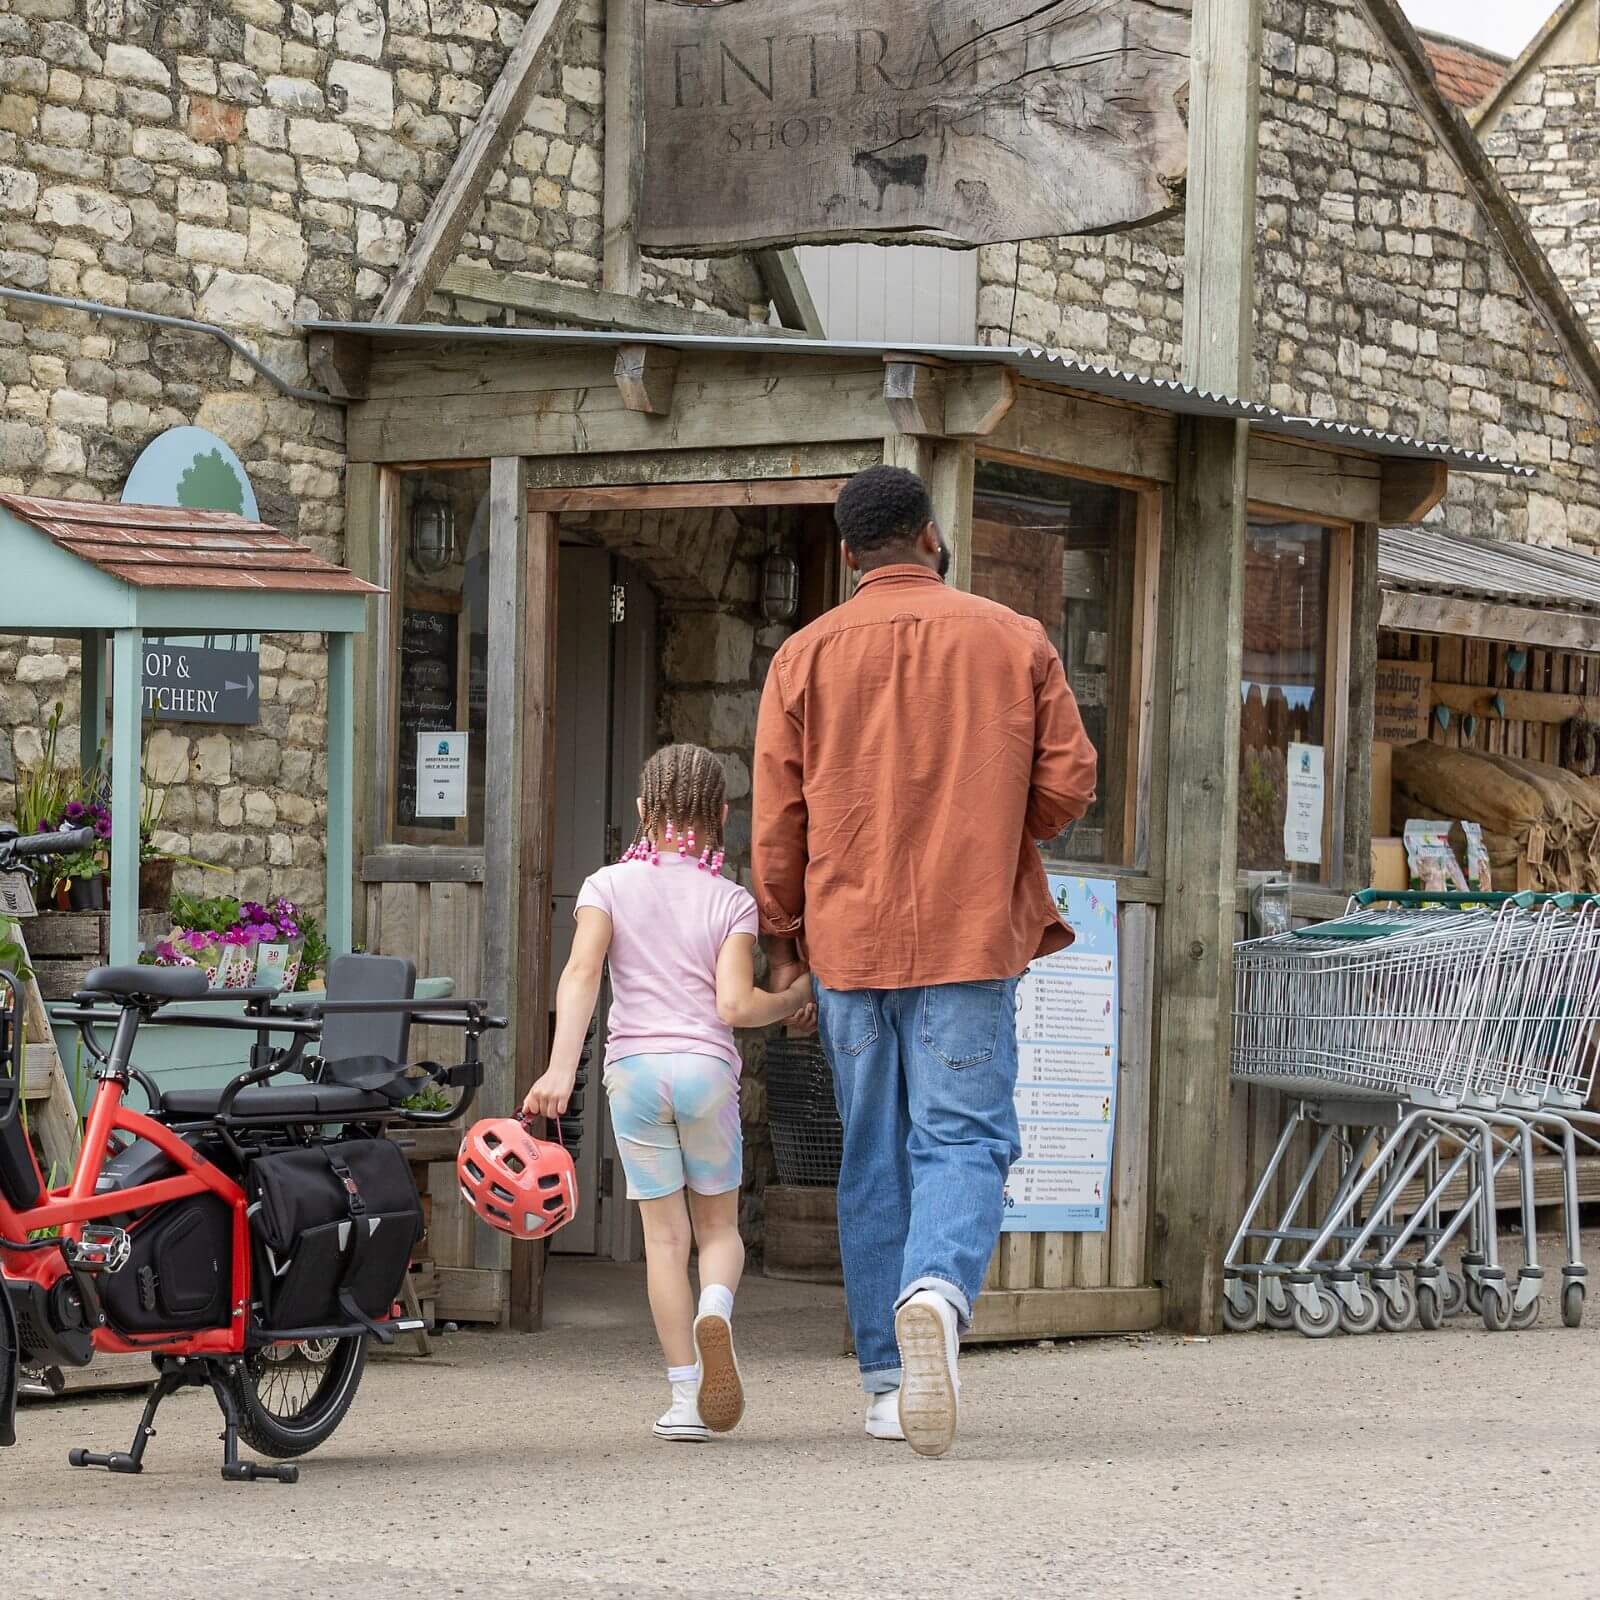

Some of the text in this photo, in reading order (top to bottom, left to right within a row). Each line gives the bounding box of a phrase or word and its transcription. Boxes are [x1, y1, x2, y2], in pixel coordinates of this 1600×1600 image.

[726, 114, 832, 153] SHOP
[145, 653, 191, 678] OP &
[142, 686, 219, 713] TCHERY
